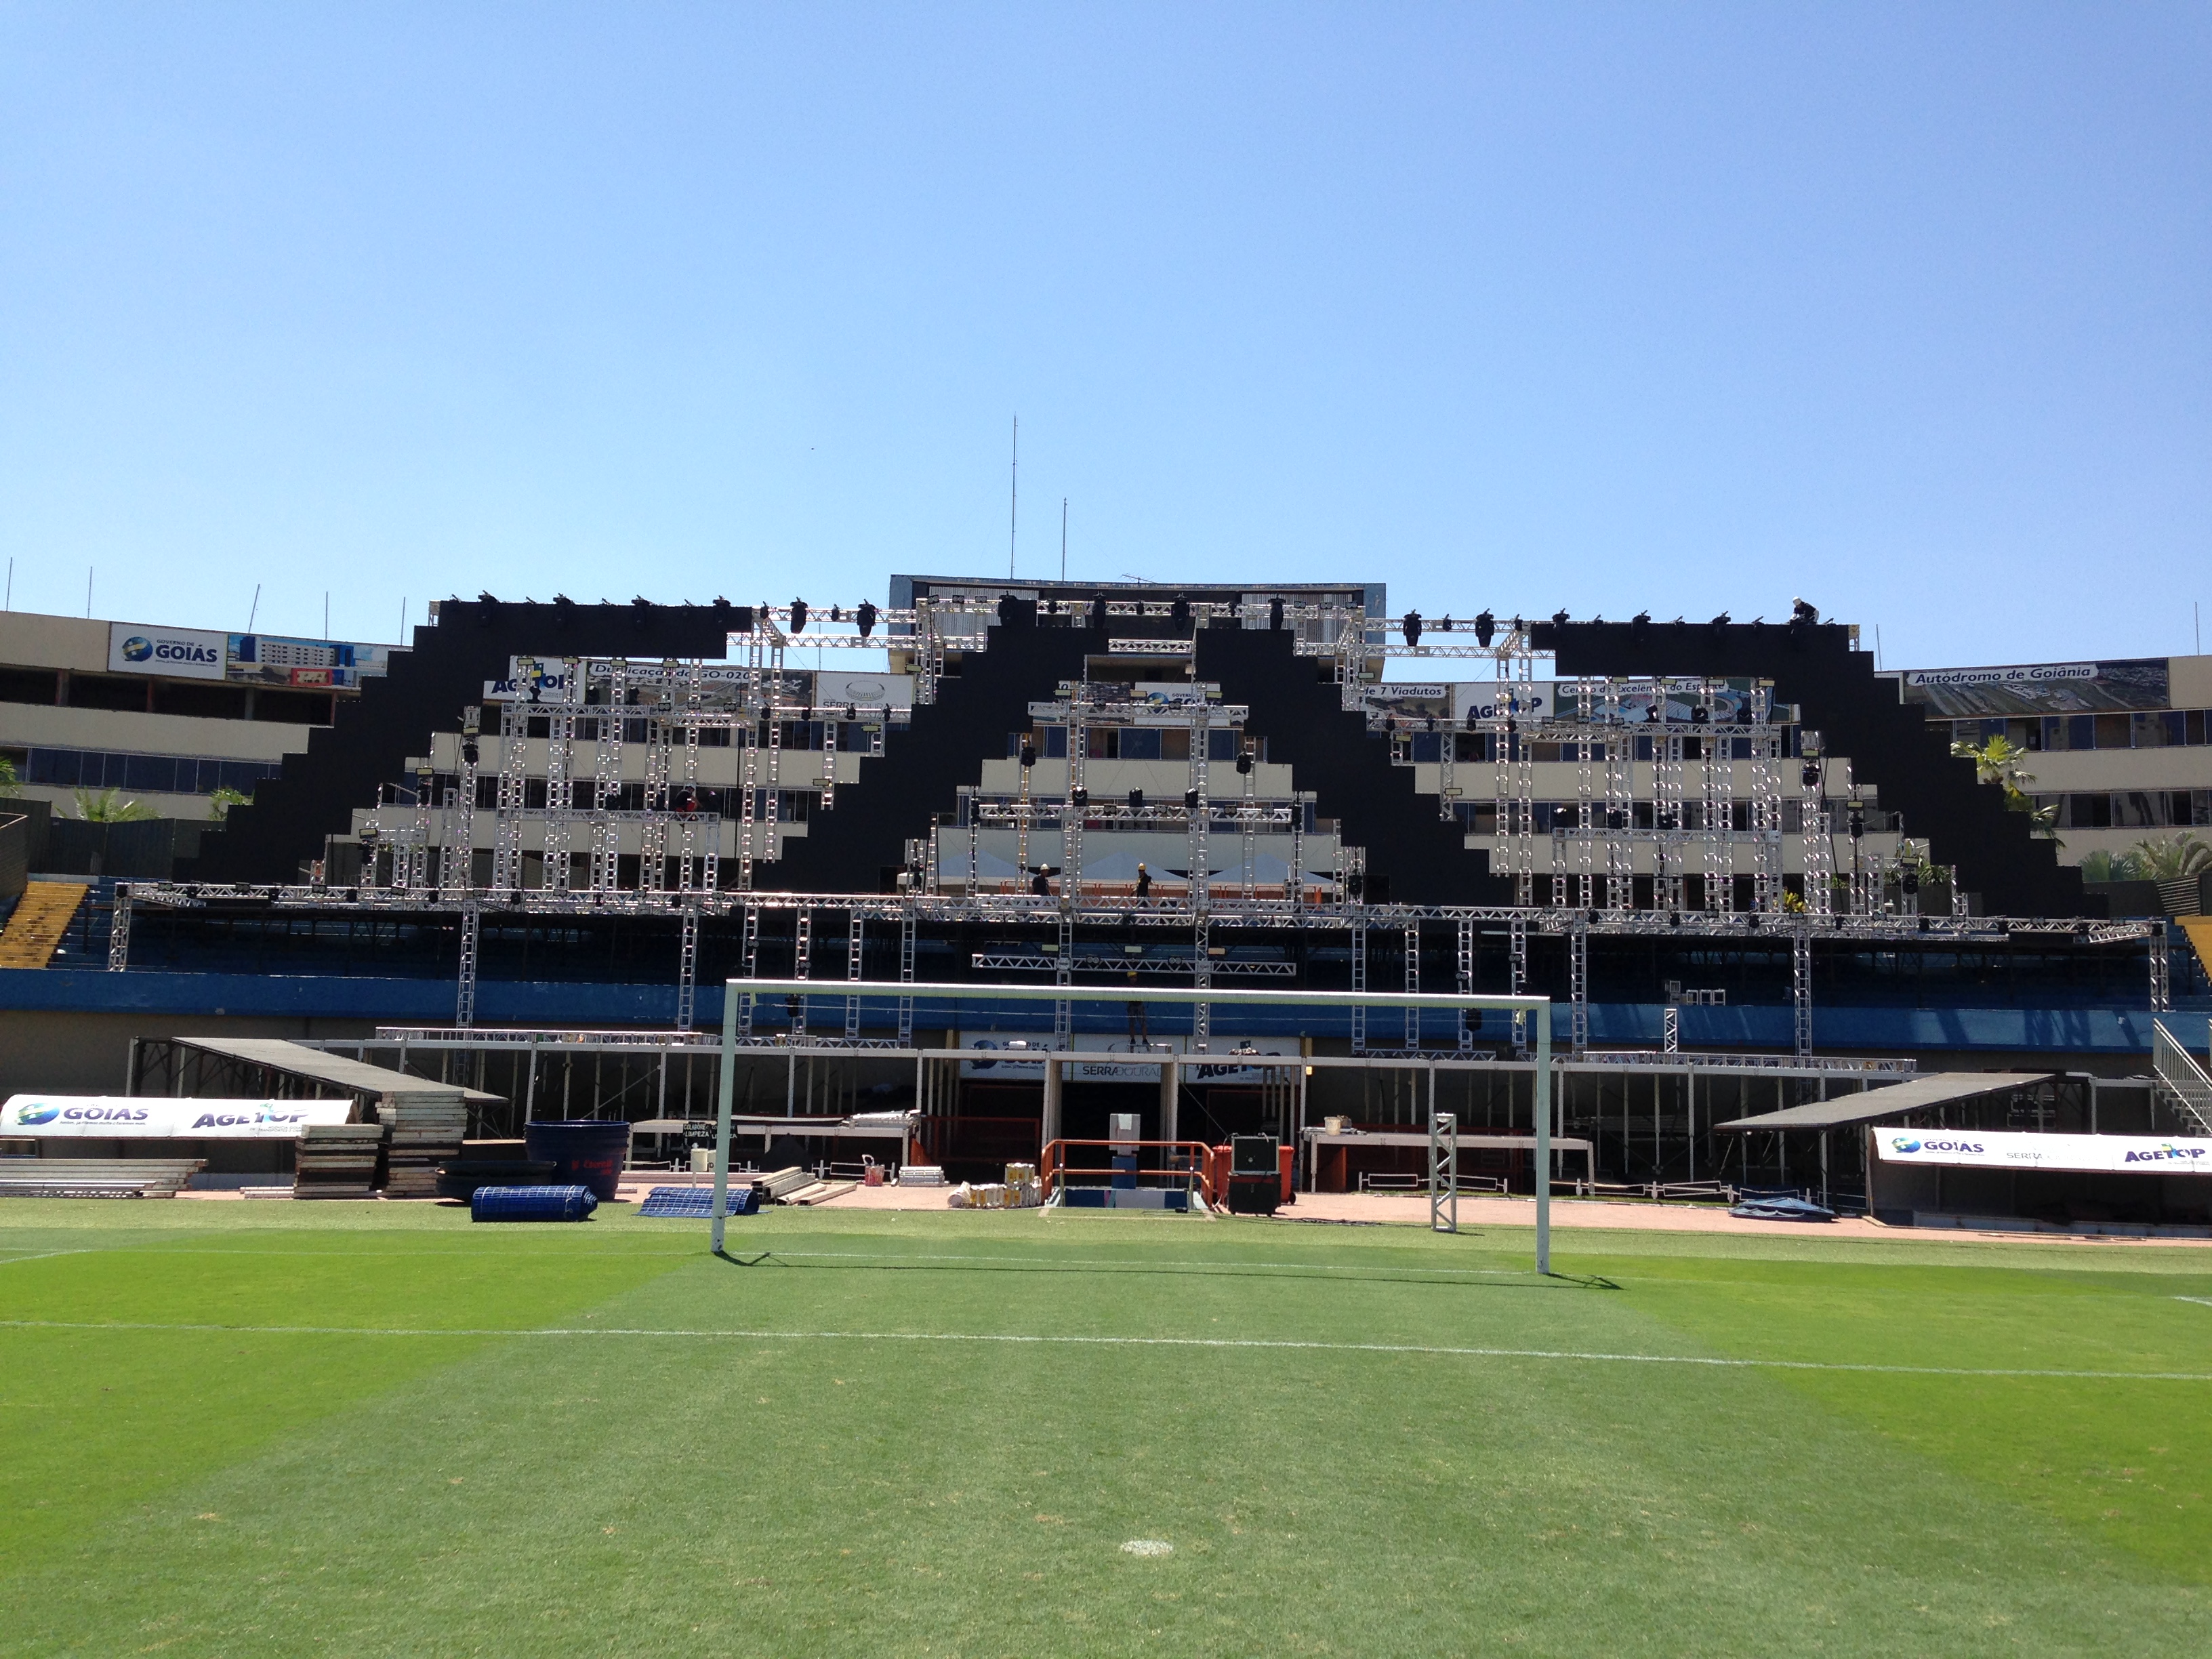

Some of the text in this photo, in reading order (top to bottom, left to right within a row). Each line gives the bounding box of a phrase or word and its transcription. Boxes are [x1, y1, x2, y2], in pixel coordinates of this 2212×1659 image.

[155, 644, 218, 663] GOIÁS
[1915, 667, 2091, 684] Autódromo de Goiânia
[1380, 687, 1387, 695] 7
[1391, 687, 1441, 695] Viadutos
[1670, 682, 1682, 691] do
[191, 1109, 309, 1128] AGETOP
[2125, 1148, 2206, 1162] AGETOP
